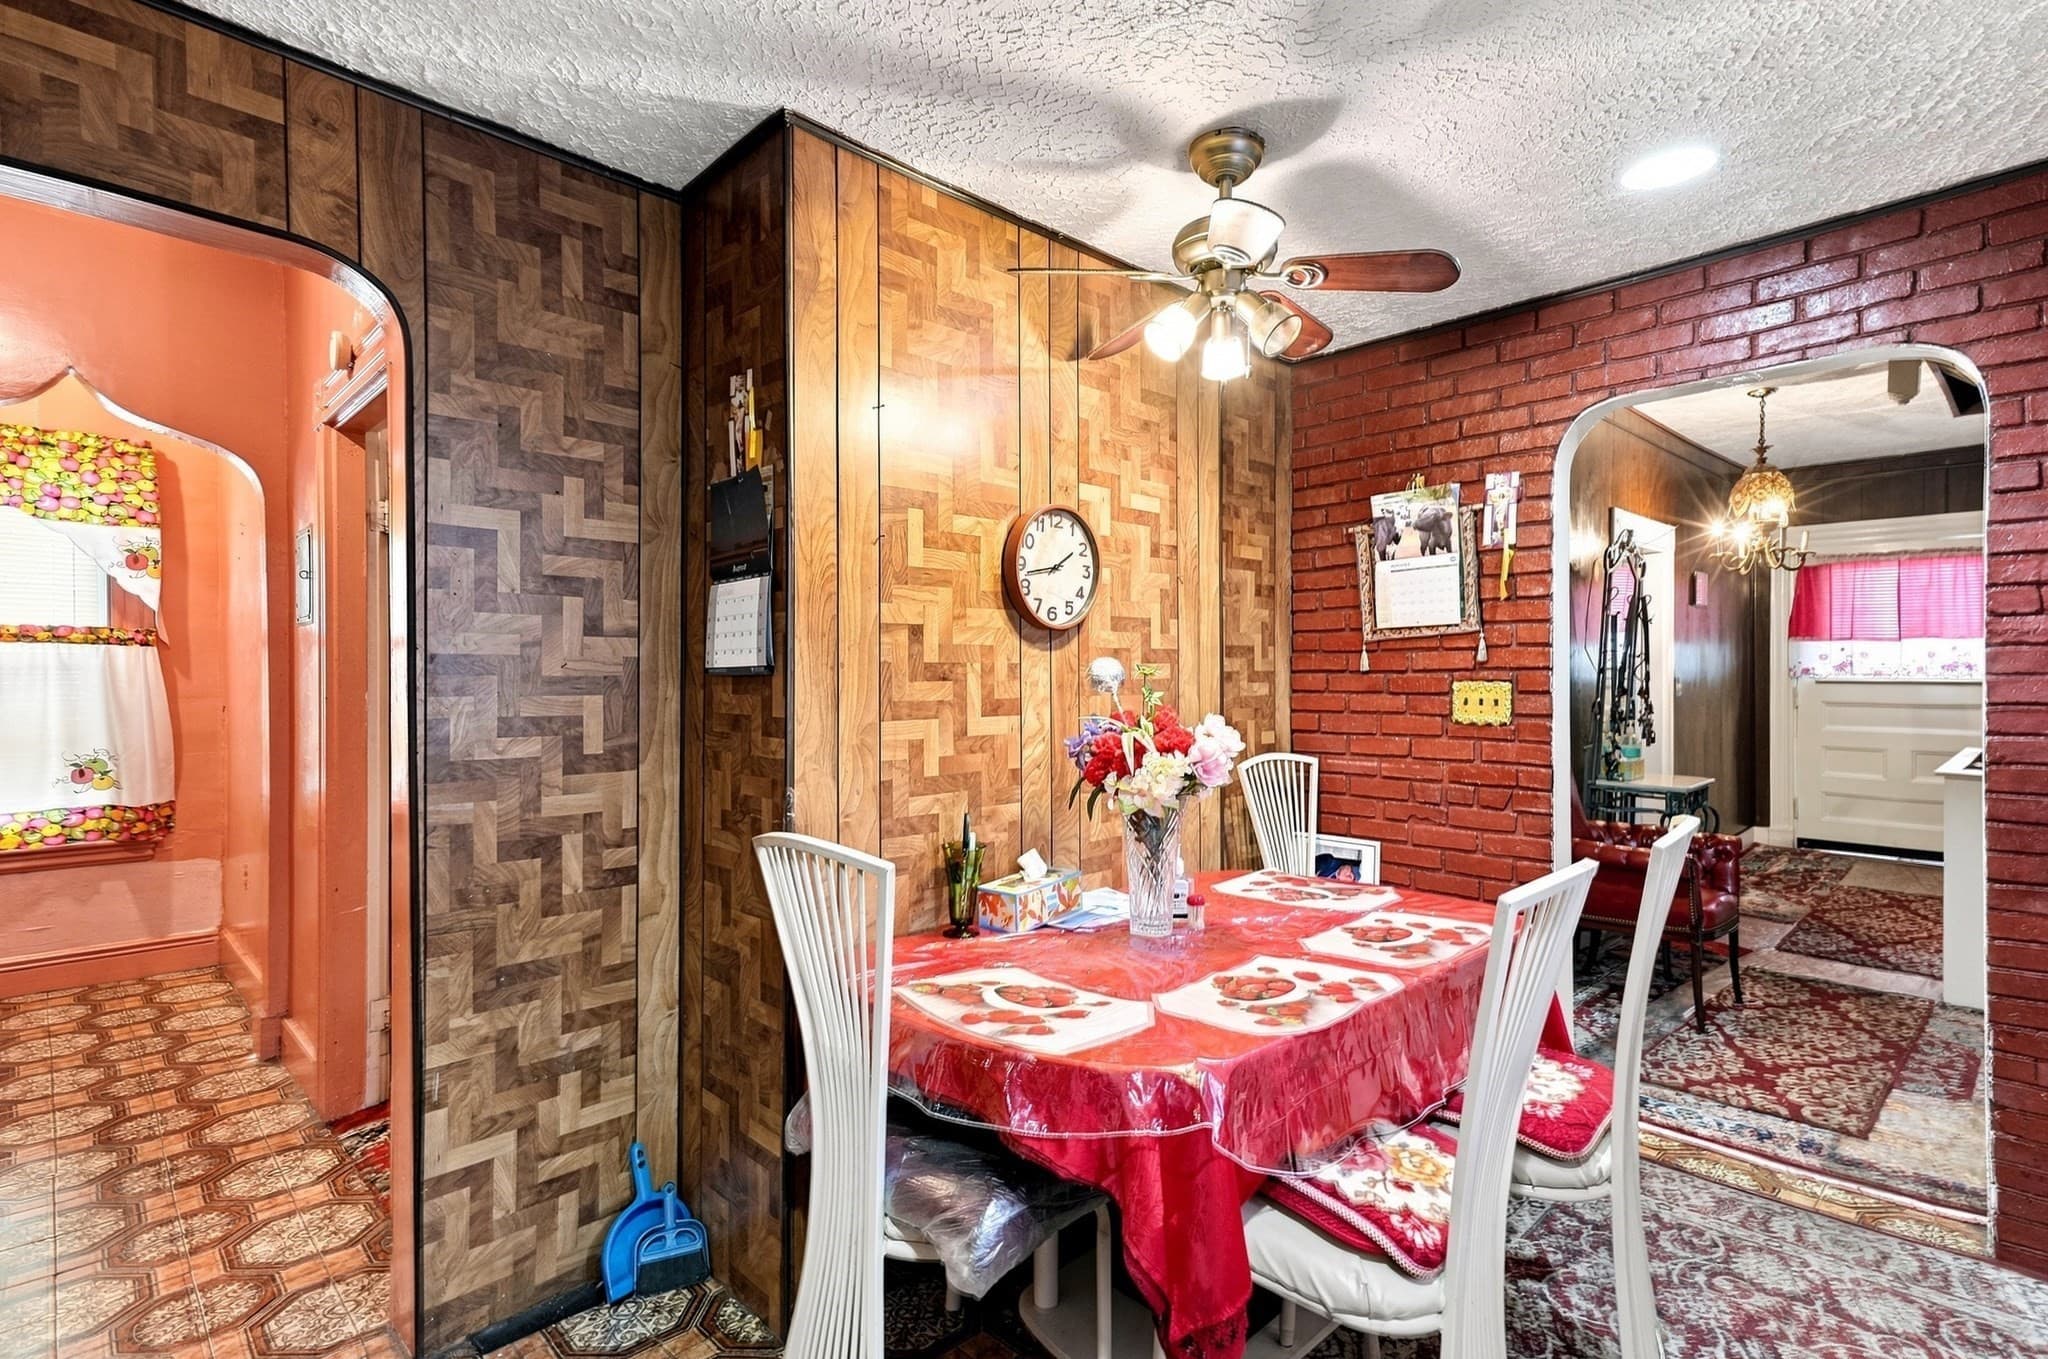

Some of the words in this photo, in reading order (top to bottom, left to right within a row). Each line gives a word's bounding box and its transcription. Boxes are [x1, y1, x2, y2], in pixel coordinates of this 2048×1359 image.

[1034, 516, 1045, 533] 11
[1048, 513, 1064, 529] 12
[1069, 520, 1076, 537] 1
[1078, 542, 1088, 557] 2
[1018, 556, 1027, 571] 9
[1082, 565, 1091, 579] 3
[1020, 578, 1031, 596] 8
[1075, 586, 1085, 600] 4
[1033, 598, 1043, 614] 7
[1047, 606, 1058, 621] 6
[1065, 600, 1074, 616] 5
